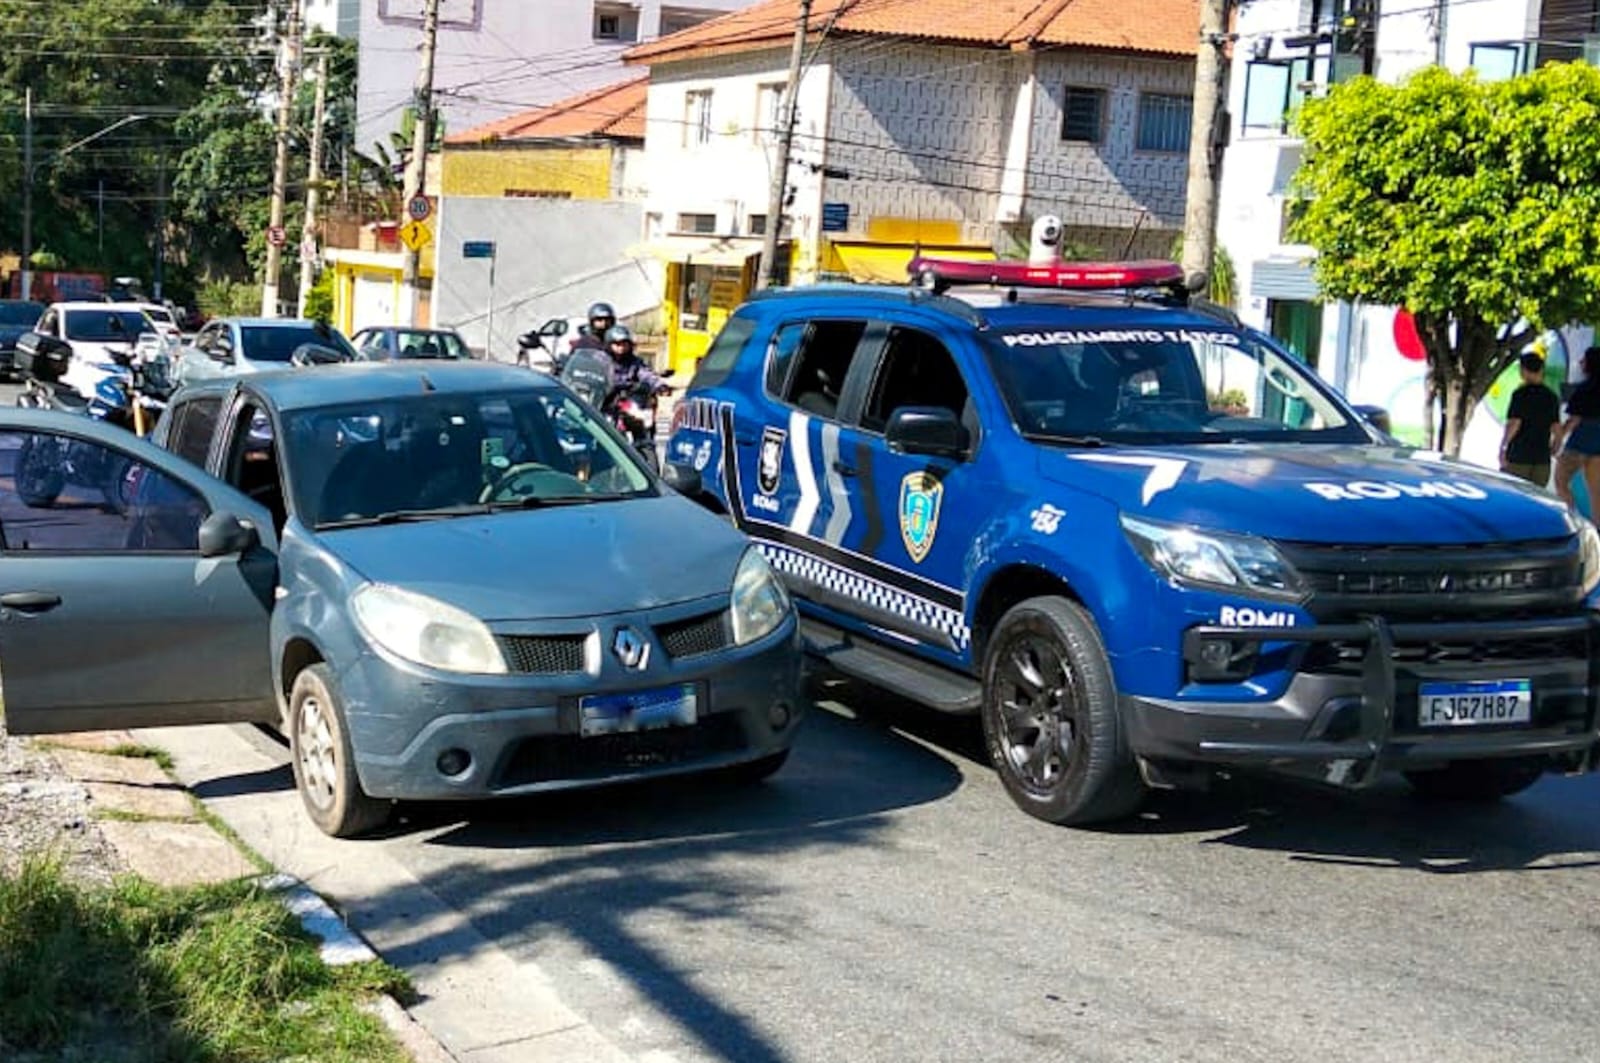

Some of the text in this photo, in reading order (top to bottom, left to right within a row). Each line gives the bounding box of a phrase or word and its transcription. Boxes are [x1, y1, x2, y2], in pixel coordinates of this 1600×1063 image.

[1003, 331, 1163, 347] POLICIAMENTO
[1303, 481, 1487, 500] ROMU
[1431, 696, 1518, 720] FJG7H87
